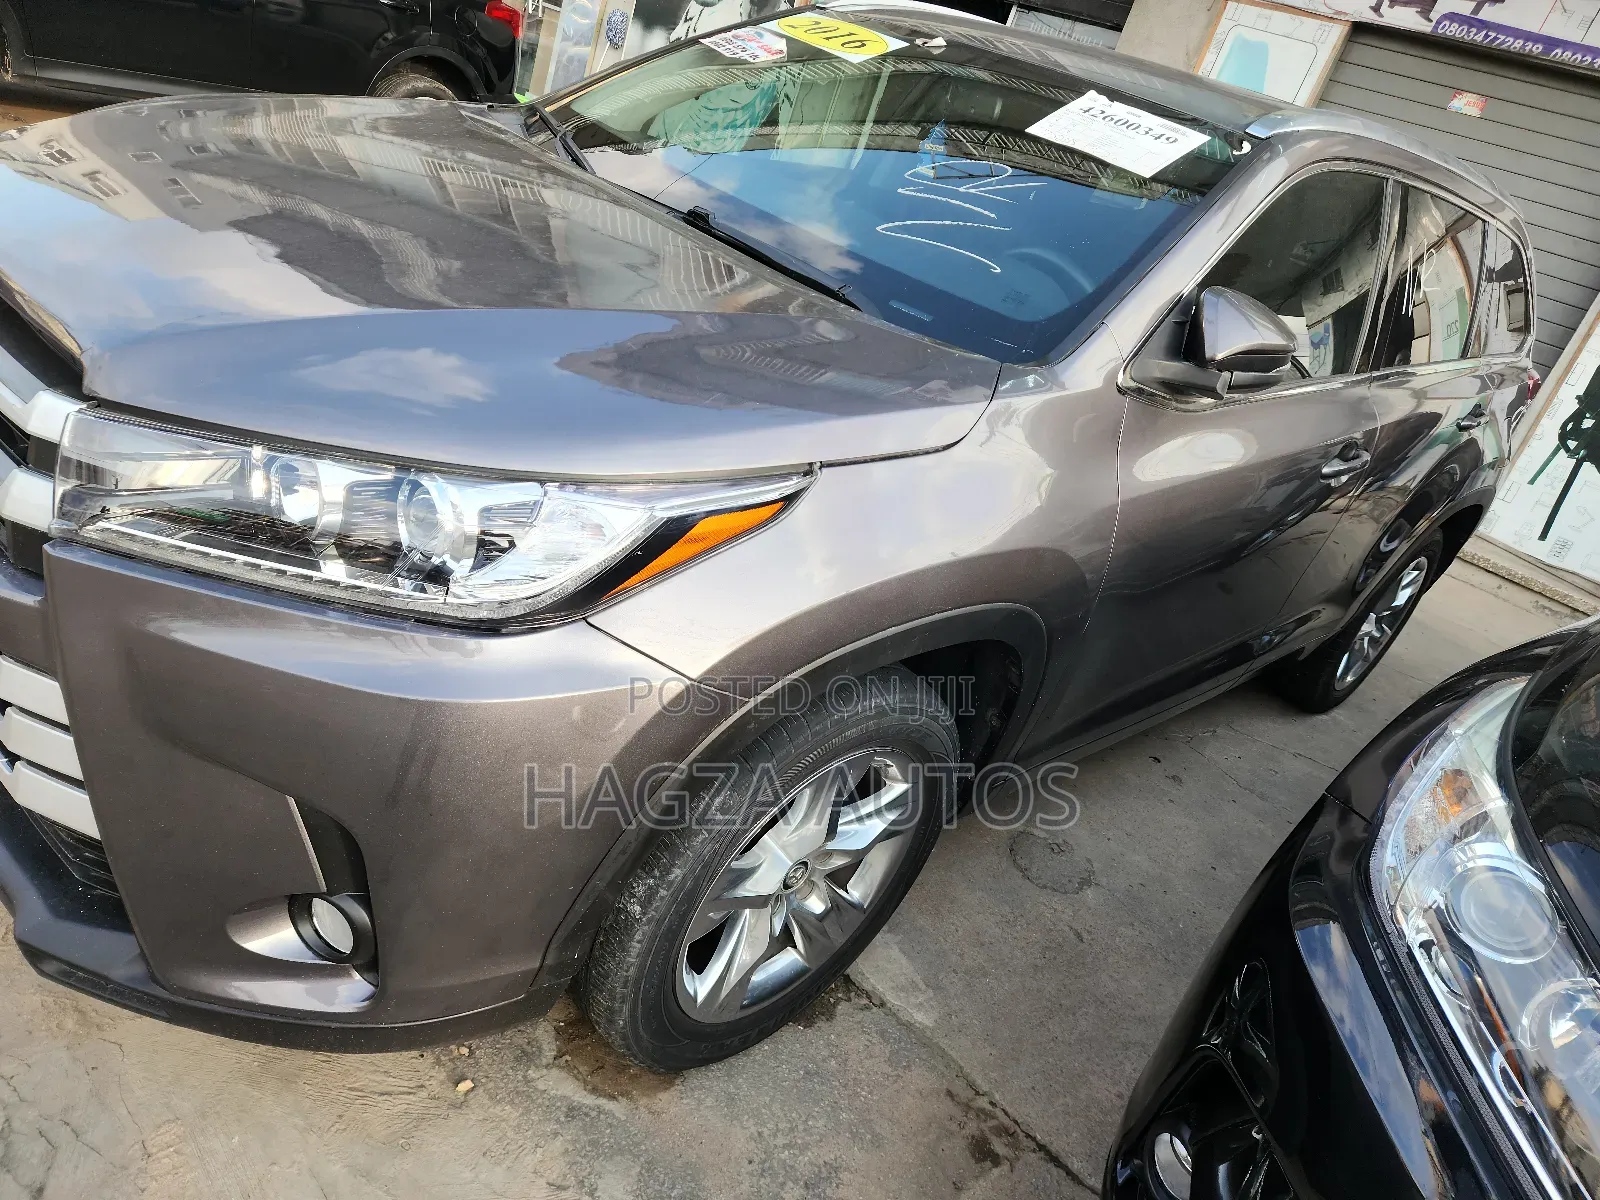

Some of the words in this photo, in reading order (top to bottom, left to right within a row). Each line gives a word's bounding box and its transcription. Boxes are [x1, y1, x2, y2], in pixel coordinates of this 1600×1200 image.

[786, 20, 871, 49] 2016
[1437, 20, 1544, 55] 08034772839
[1079, 105, 1179, 145] 42600349
